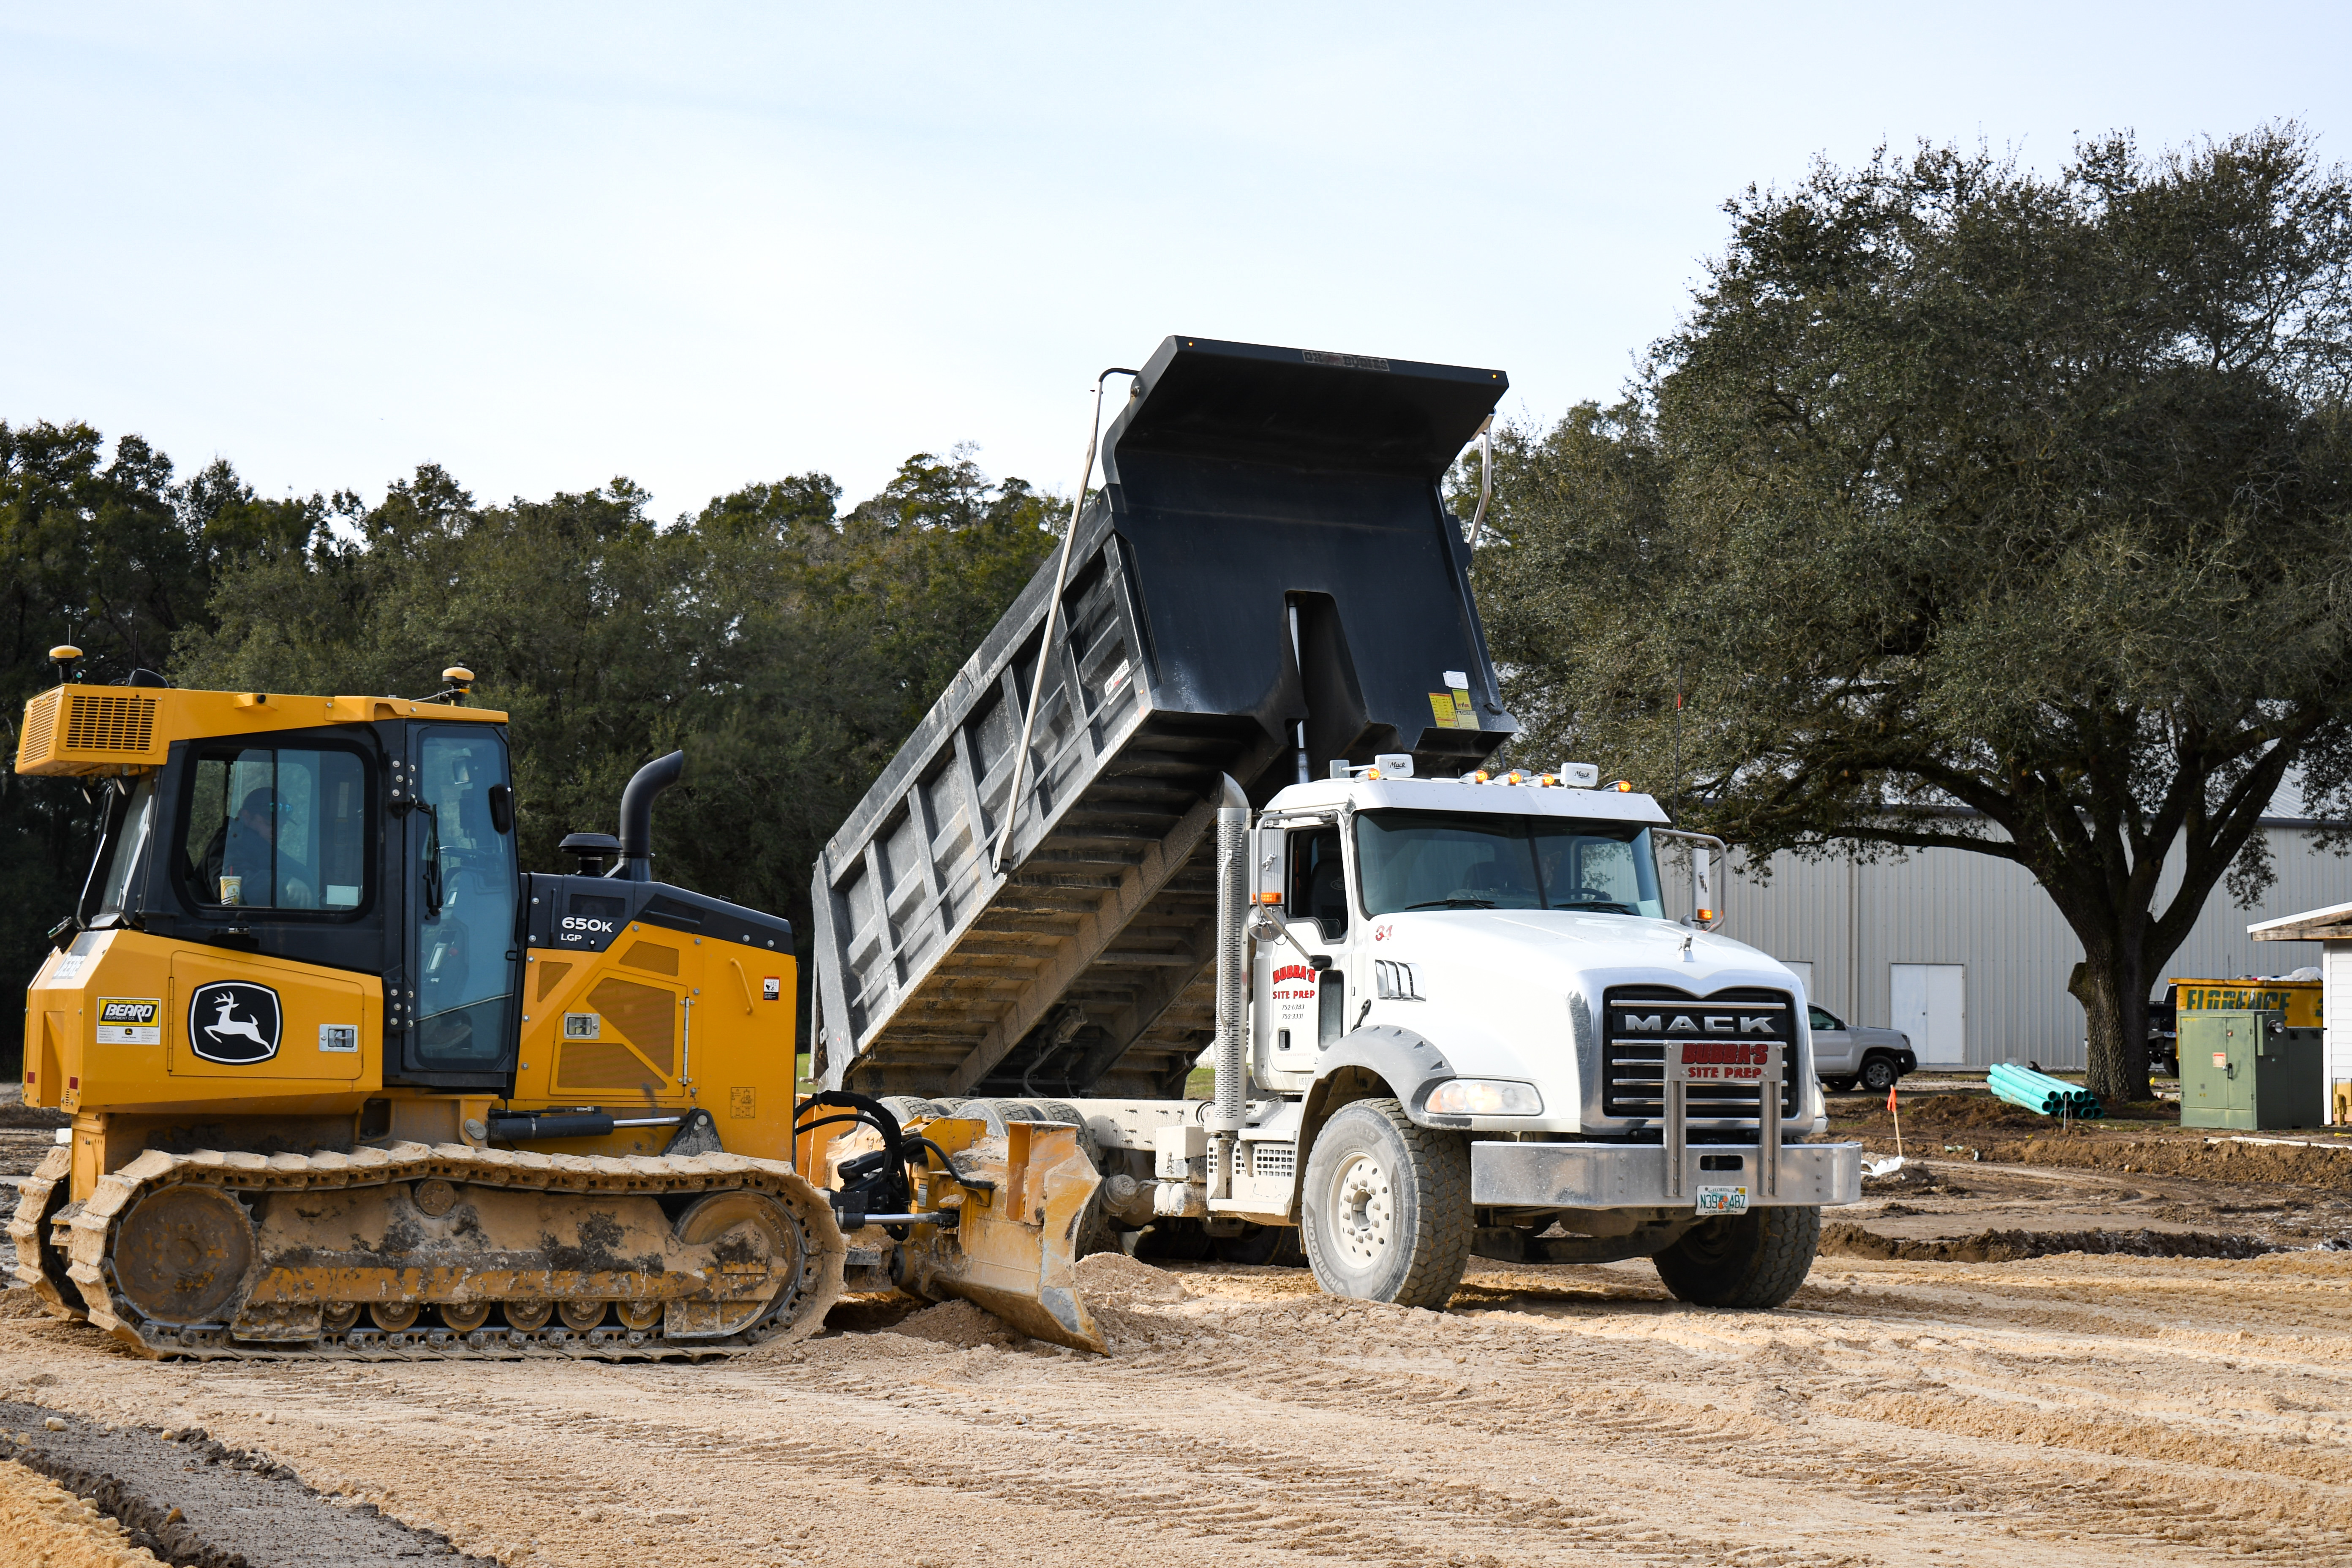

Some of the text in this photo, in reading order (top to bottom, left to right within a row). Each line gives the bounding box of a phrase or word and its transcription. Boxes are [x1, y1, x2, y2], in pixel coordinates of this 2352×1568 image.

[1343, 356, 1387, 370] BODIES
[1112, 662, 1128, 683] BODIES
[1097, 747, 1113, 769] GVW
[1114, 713, 1138, 749] 64000
[562, 917, 613, 933] 650K
[561, 933, 582, 942] LGP
[1273, 965, 1316, 985] BUBBA'S
[1273, 990, 1315, 999] SITE PREP
[105, 1004, 153, 1023] BEARD
[1625, 1015, 1775, 1032] MACK
[1681, 1043, 1768, 1064] BUBBA'S
[1688, 1067, 1762, 1078] SITE PREP
[1700, 1194, 1718, 1209] N39
